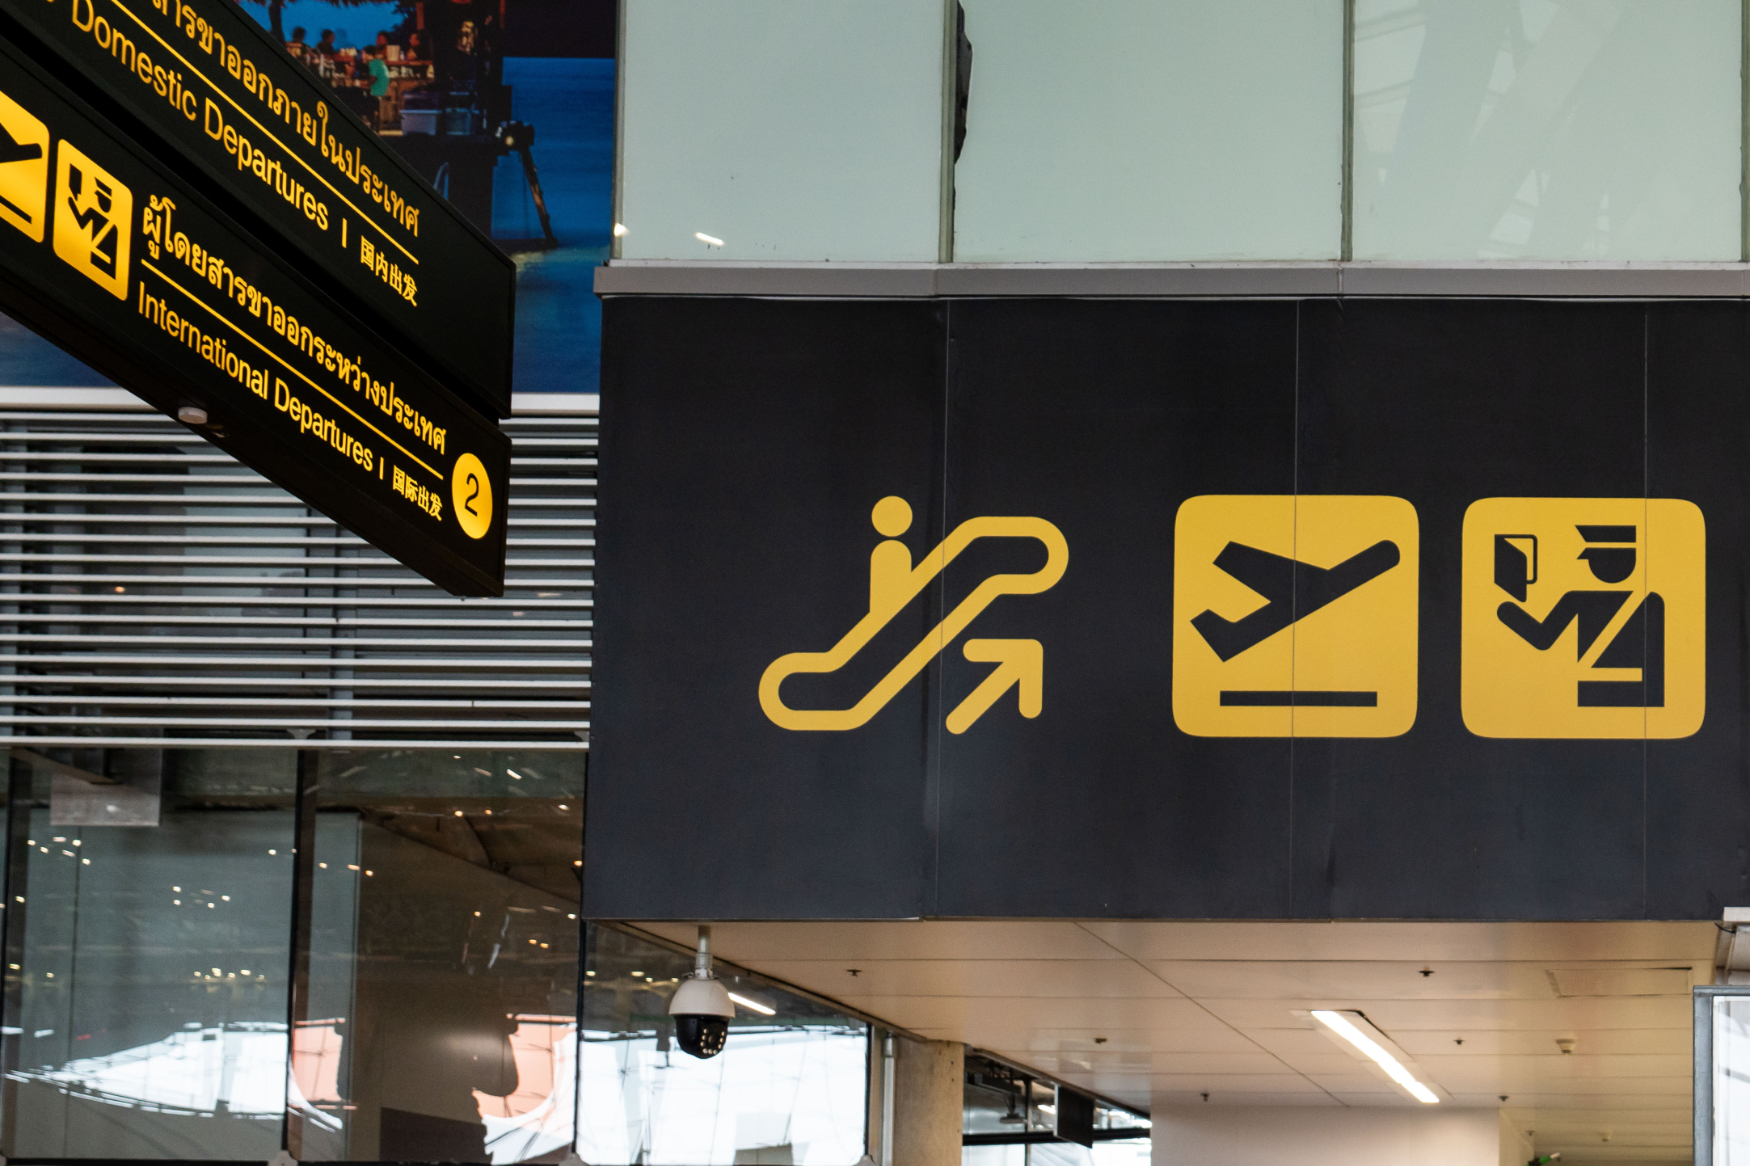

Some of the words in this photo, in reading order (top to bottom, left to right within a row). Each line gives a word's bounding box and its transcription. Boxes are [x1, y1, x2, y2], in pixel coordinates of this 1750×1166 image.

[72, 0, 198, 121] Domestic
[204, 97, 328, 231] Departures
[143, 194, 446, 454] ผู้โดยสารขาออกระหว่างประเทศ
[360, 234, 418, 306] 国内出发
[138, 282, 268, 400] International
[274, 377, 373, 472] Departures
[392, 464, 443, 521] 国际出发
[463, 473, 480, 516] 2
